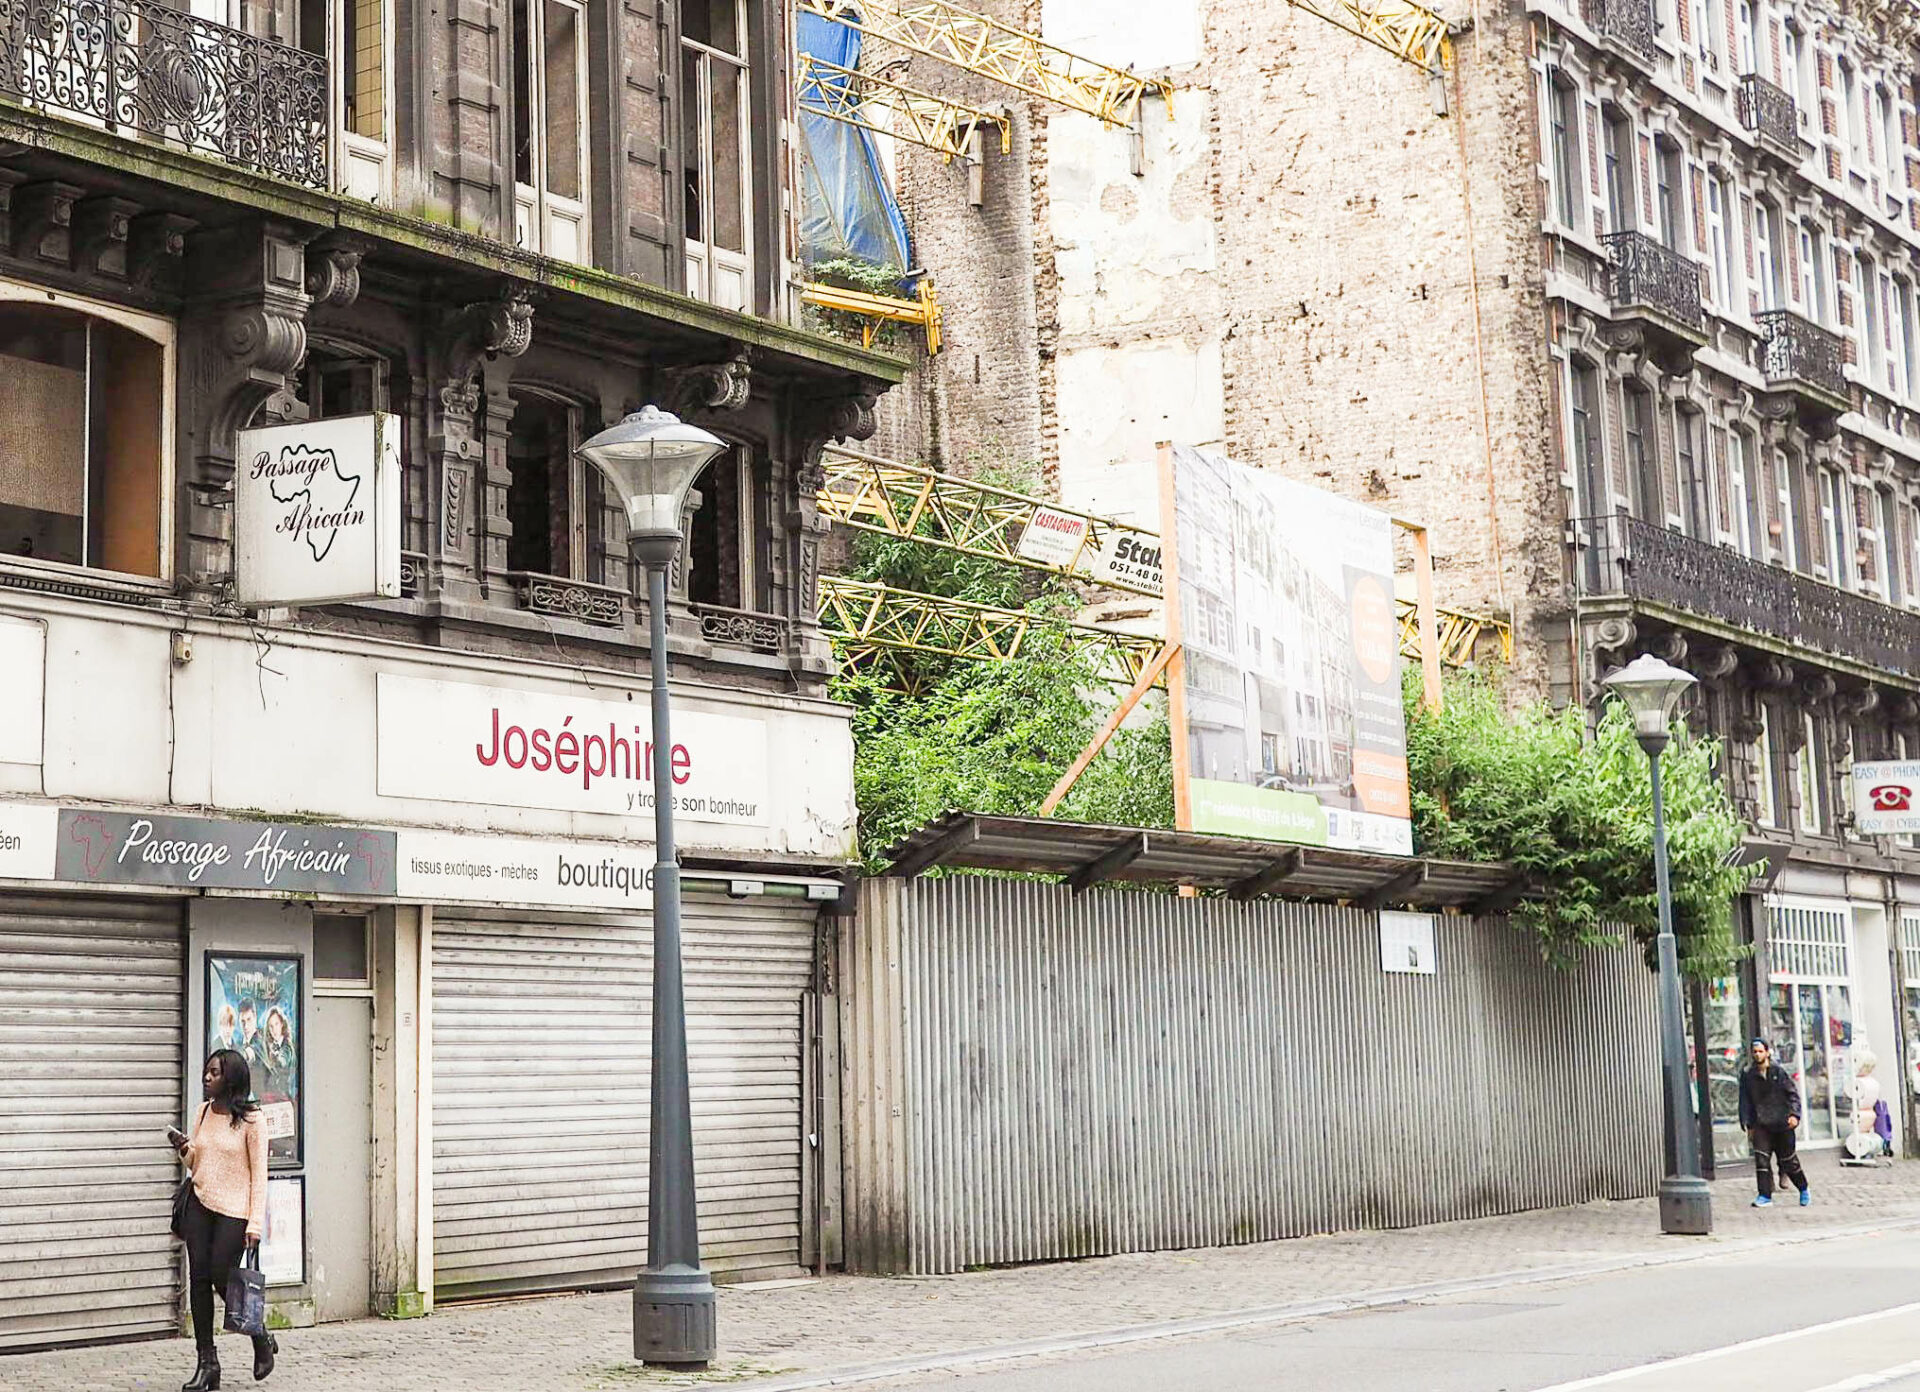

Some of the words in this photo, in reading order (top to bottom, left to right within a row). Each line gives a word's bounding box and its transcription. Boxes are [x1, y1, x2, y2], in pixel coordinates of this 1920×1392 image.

[250, 451, 330, 486] Passage
[276, 502, 364, 542] Africain
[1035, 512, 1083, 537] CASTAGNETTI
[1855, 767, 1878, 780] EASY
[627, 792, 635, 811] y
[638, 790, 678, 810] troe
[681, 797, 706, 812] son
[709, 796, 757, 817] bonheur
[117, 819, 231, 882] Passage
[243, 826, 352, 885] Africain
[411, 857, 441, 875] tissus
[444, 859, 492, 881] exotiques
[501, 863, 538, 881] mèches
[557, 854, 654, 897] boutique
